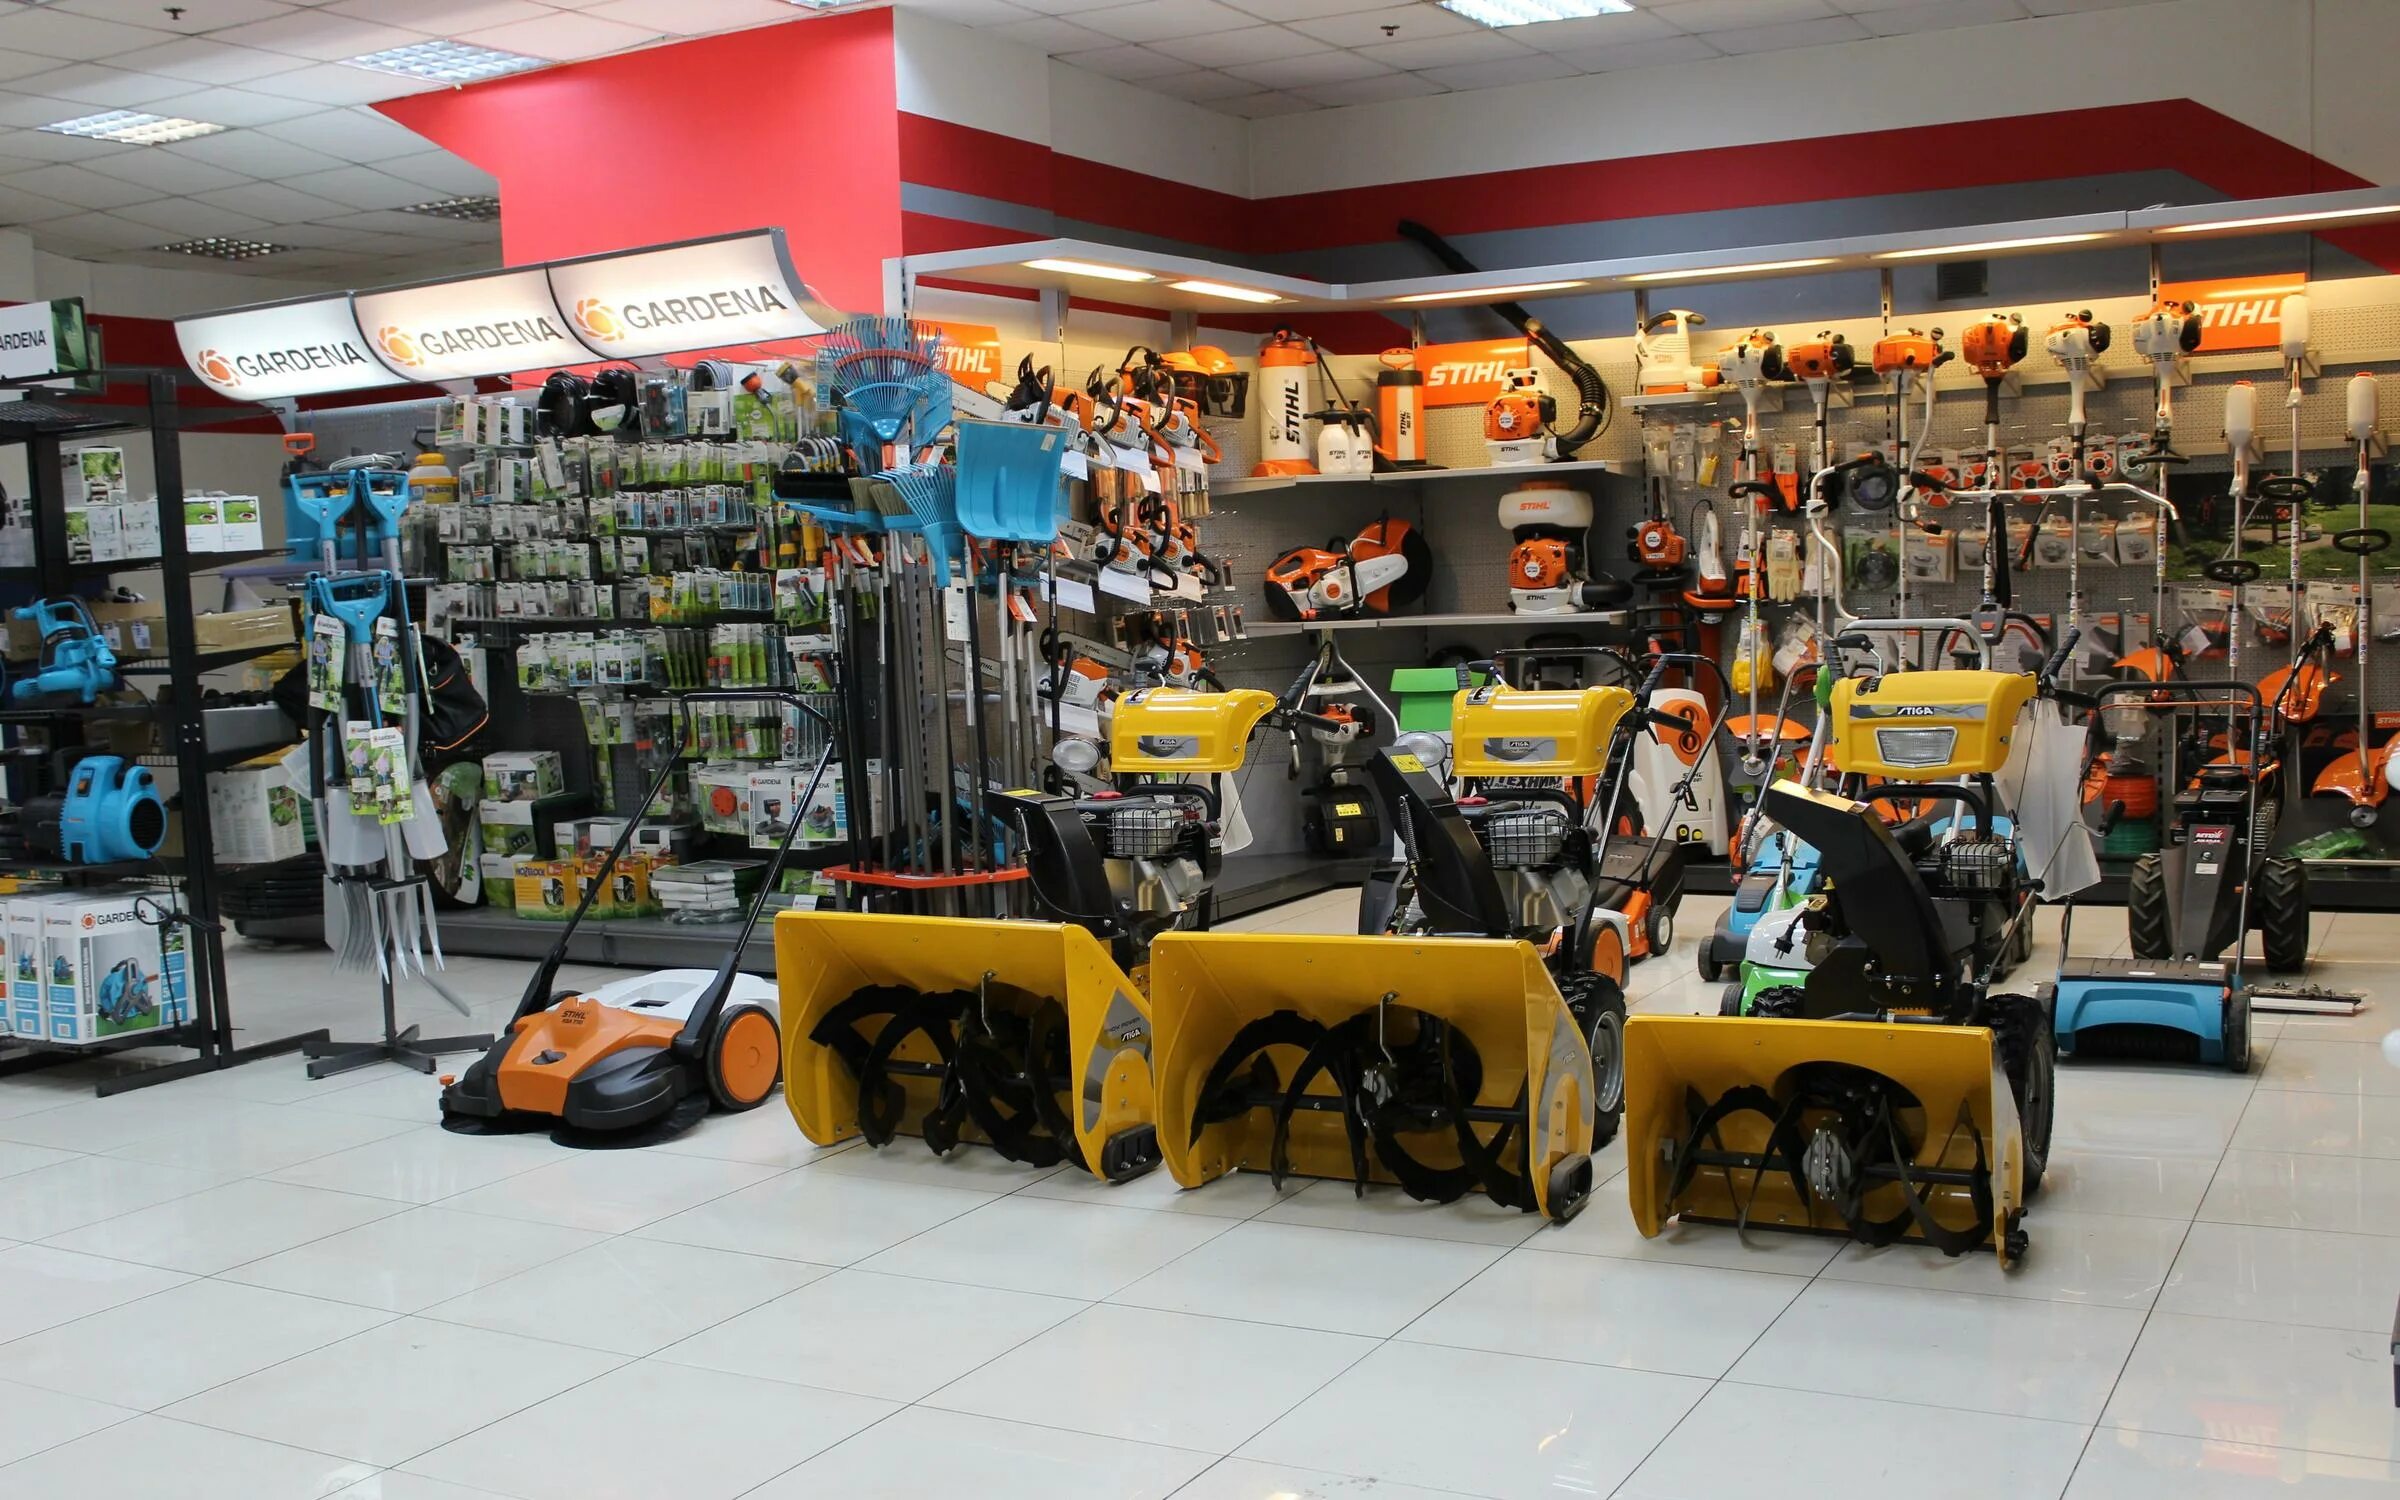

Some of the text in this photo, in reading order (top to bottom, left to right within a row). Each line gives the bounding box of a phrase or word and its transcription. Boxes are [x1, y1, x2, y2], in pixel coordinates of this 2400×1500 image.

[623, 286, 788, 329] GARDENA
[2196, 300, 2281, 328] TIHL
[420, 317, 564, 356] GARDENA
[236, 341, 368, 377] GARDENA
[1427, 360, 1506, 387] STIHL
[1286, 382, 1300, 444] STIHL
[1520, 501, 1551, 511] STIHL
[1897, 706, 1934, 715] STIGA
[562, 1010, 586, 1020] STIHL
[1121, 1028, 1141, 1042] STIGA
